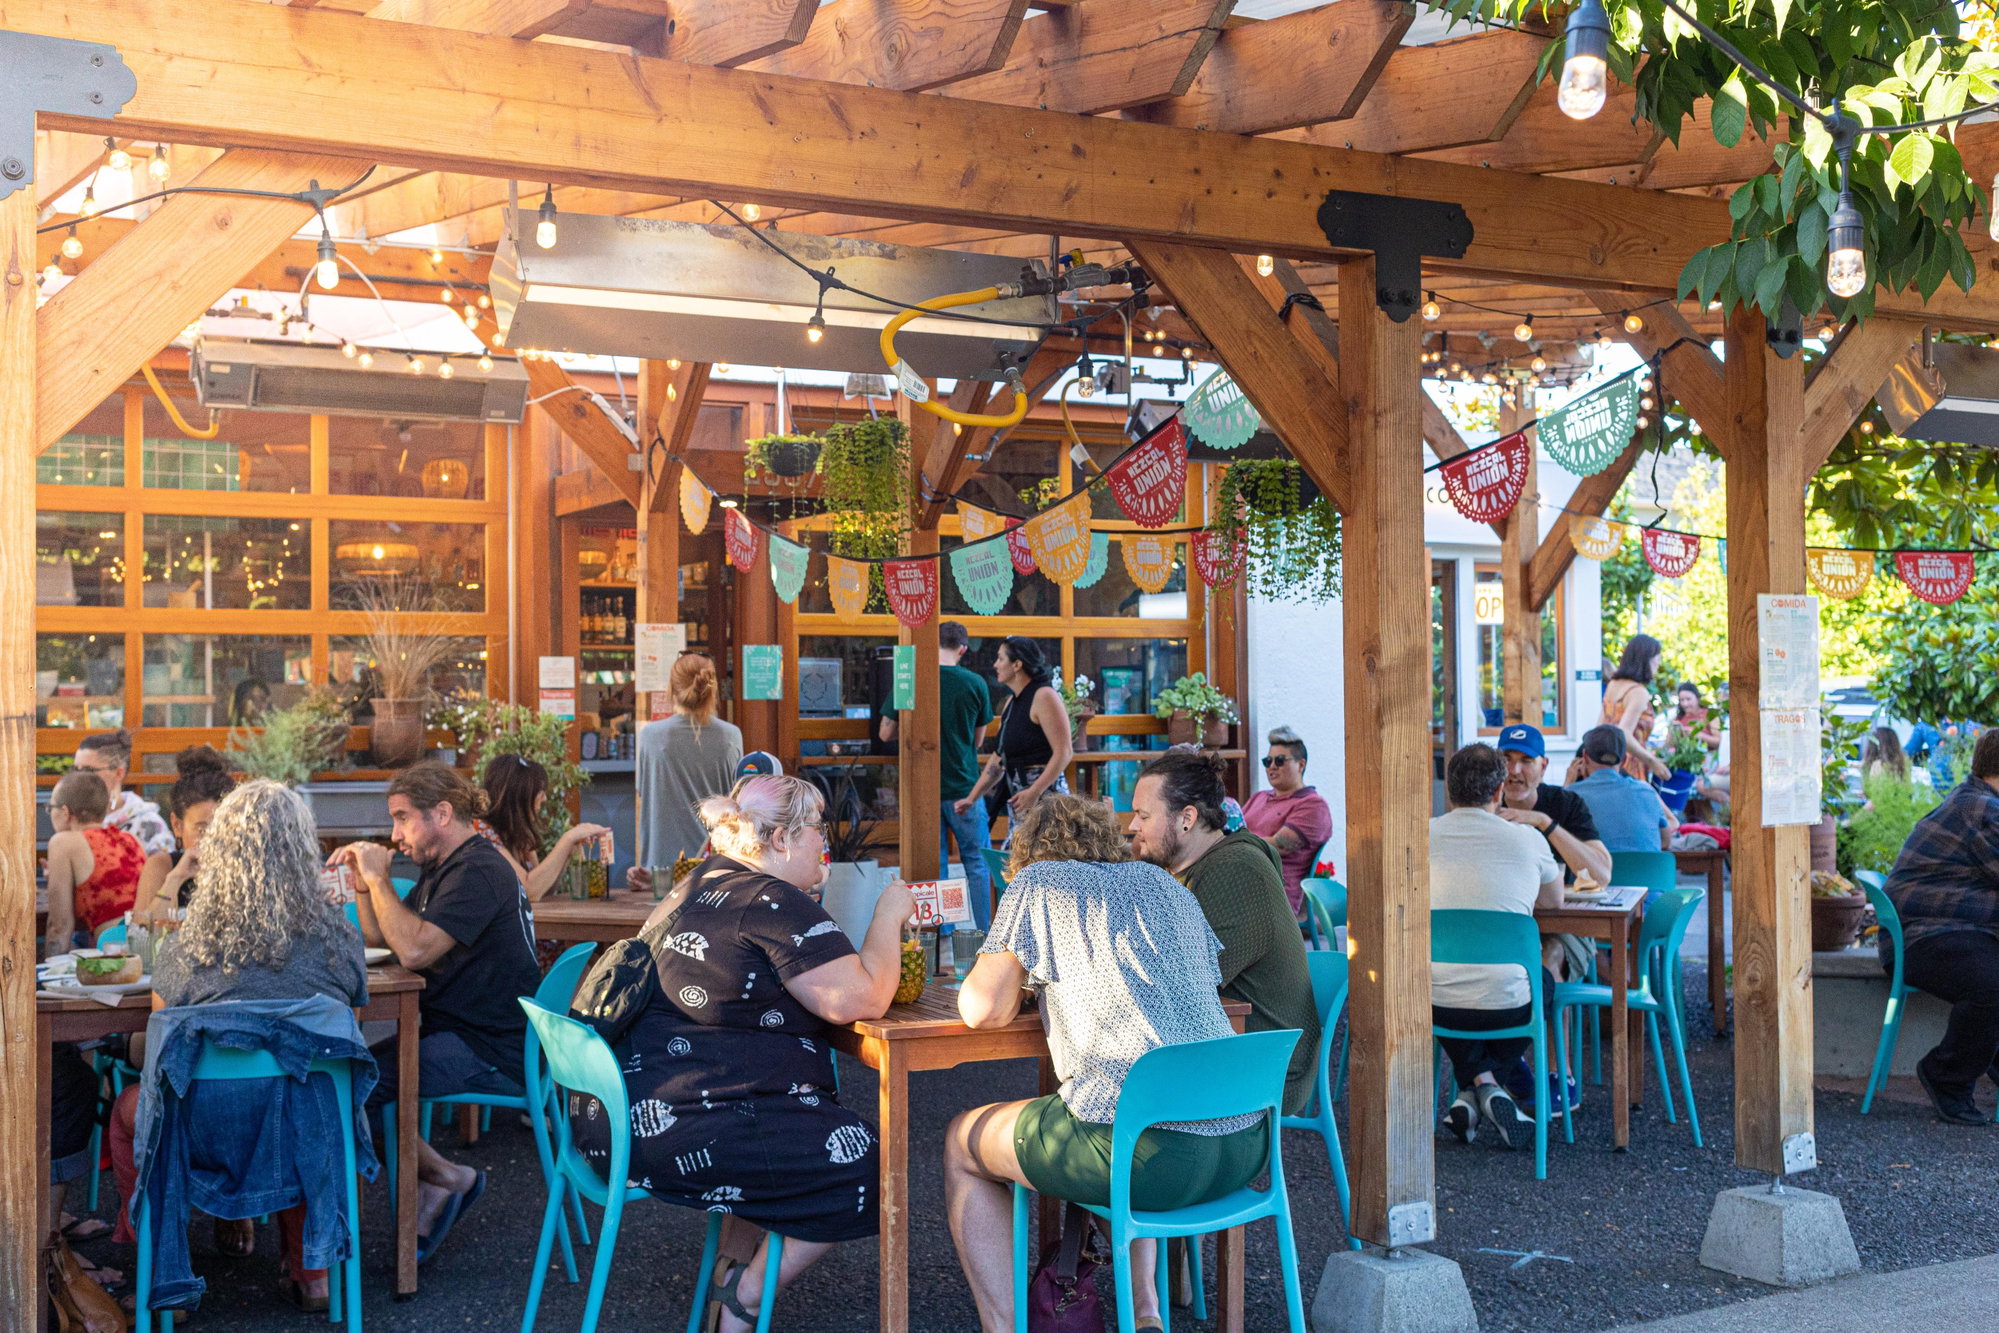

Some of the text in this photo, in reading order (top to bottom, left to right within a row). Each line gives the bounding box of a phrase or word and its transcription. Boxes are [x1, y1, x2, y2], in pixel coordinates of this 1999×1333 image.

[1127, 447, 1166, 478] MEZCAL
[1465, 451, 1506, 477] MEZCAL
[1822, 555, 1854, 565] MEZCAL
[1918, 559, 1954, 568] MEZCAL
[896, 569, 923, 580] MEZCAL
[1770, 599, 1806, 609] COMIDA
